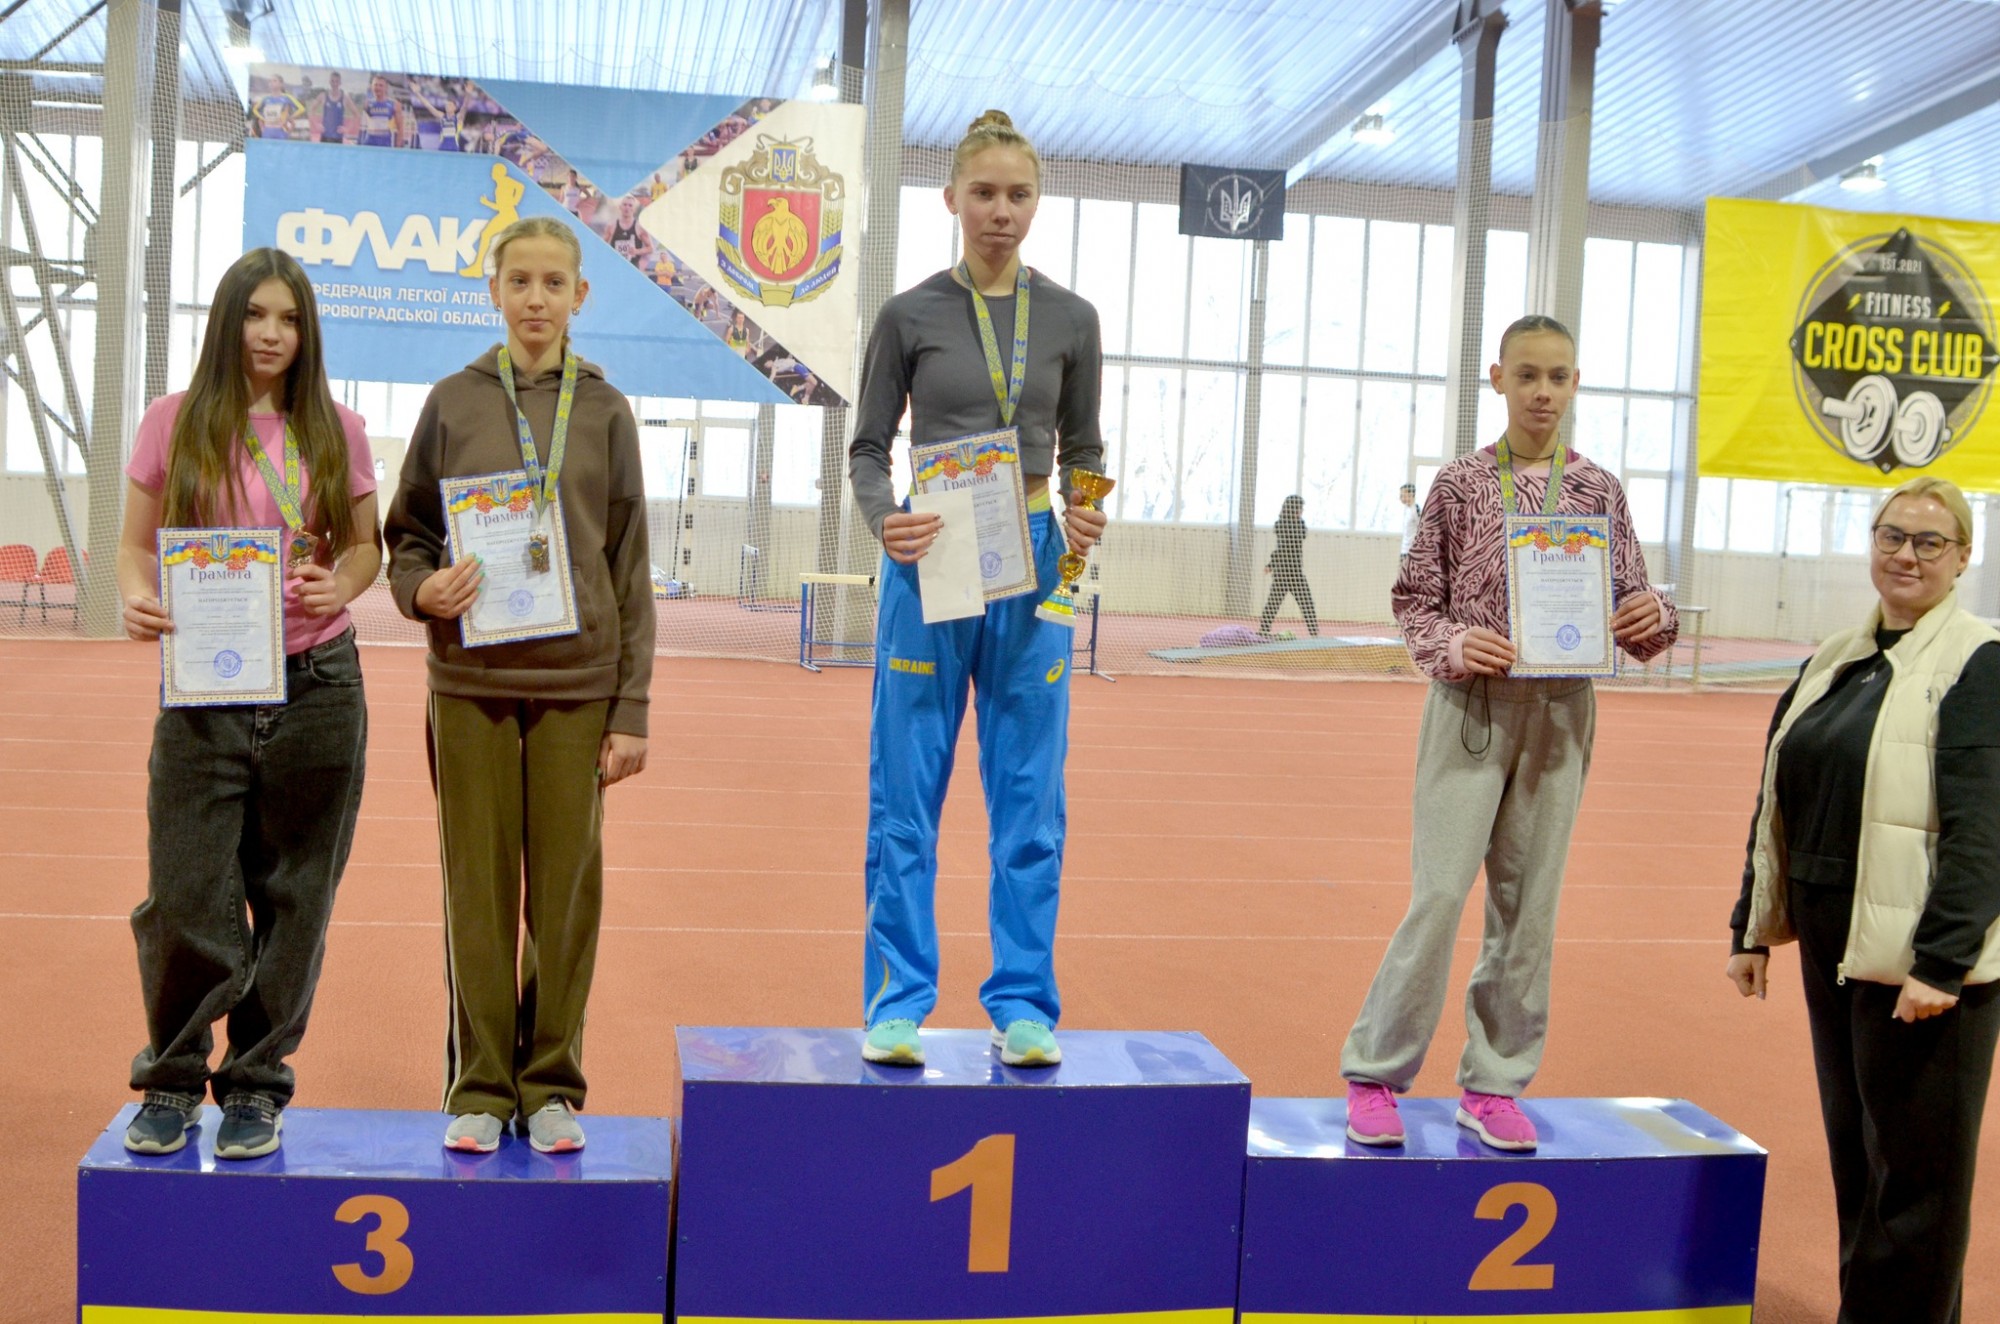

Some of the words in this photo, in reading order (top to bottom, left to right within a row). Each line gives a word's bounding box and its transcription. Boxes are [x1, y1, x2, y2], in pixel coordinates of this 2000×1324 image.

[396, 287, 447, 304] ЛЕГКОЇ
[1865, 291, 1931, 319] FITNESS
[317, 303, 437, 323] ІРОВОГРАДСЬКОЇ
[442, 310, 503, 327] ОБЛАСТІ
[1804, 320, 1903, 374] CROSS
[1910, 330, 1983, 378] CLUB
[942, 472, 998, 491] Грамота
[475, 511, 534, 527] Грамота
[1533, 550, 1585, 565] Грамота
[190, 567, 251, 583] Грамота
[930, 1134, 1015, 1272] 1
[331, 1194, 414, 1295] 3
[1468, 1181, 1558, 1290] 2
